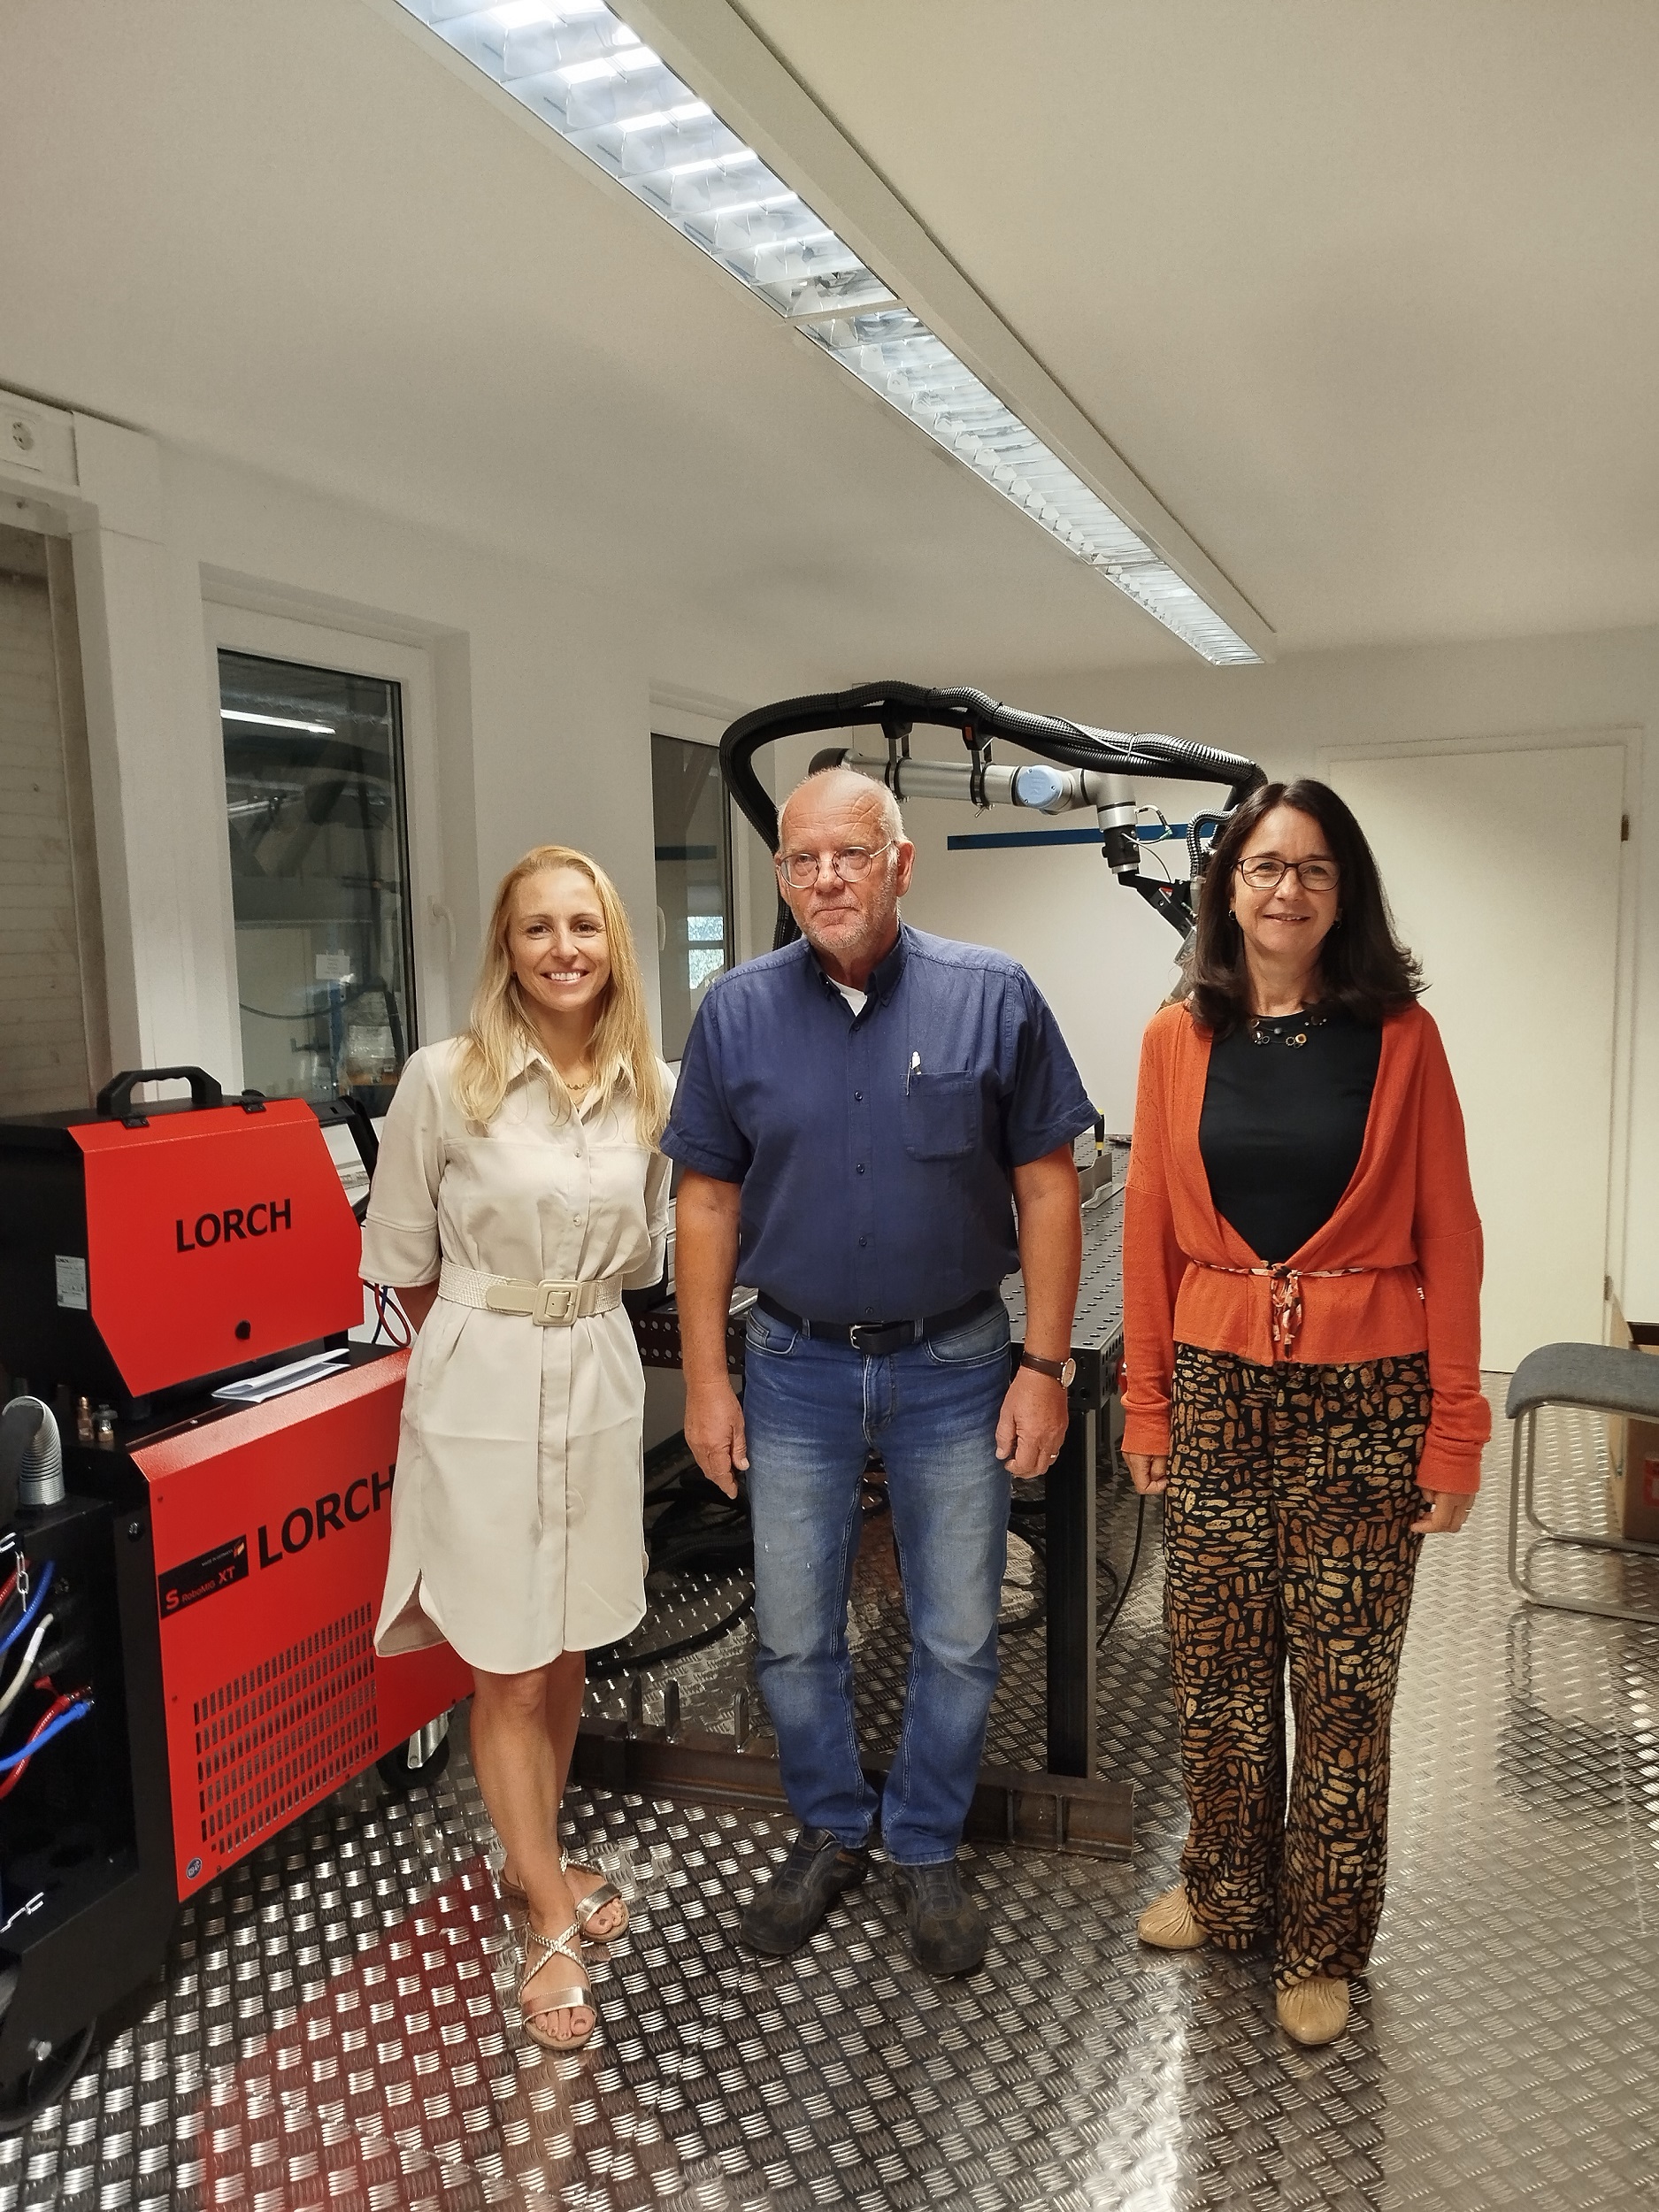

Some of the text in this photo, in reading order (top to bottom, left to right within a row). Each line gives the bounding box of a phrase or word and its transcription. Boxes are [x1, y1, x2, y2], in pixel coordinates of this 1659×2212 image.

[176, 1198, 291, 1253] LORCH
[257, 1463, 396, 1571] LORCH
[165, 1588, 180, 1610] S
[219, 1565, 235, 1585] XT
